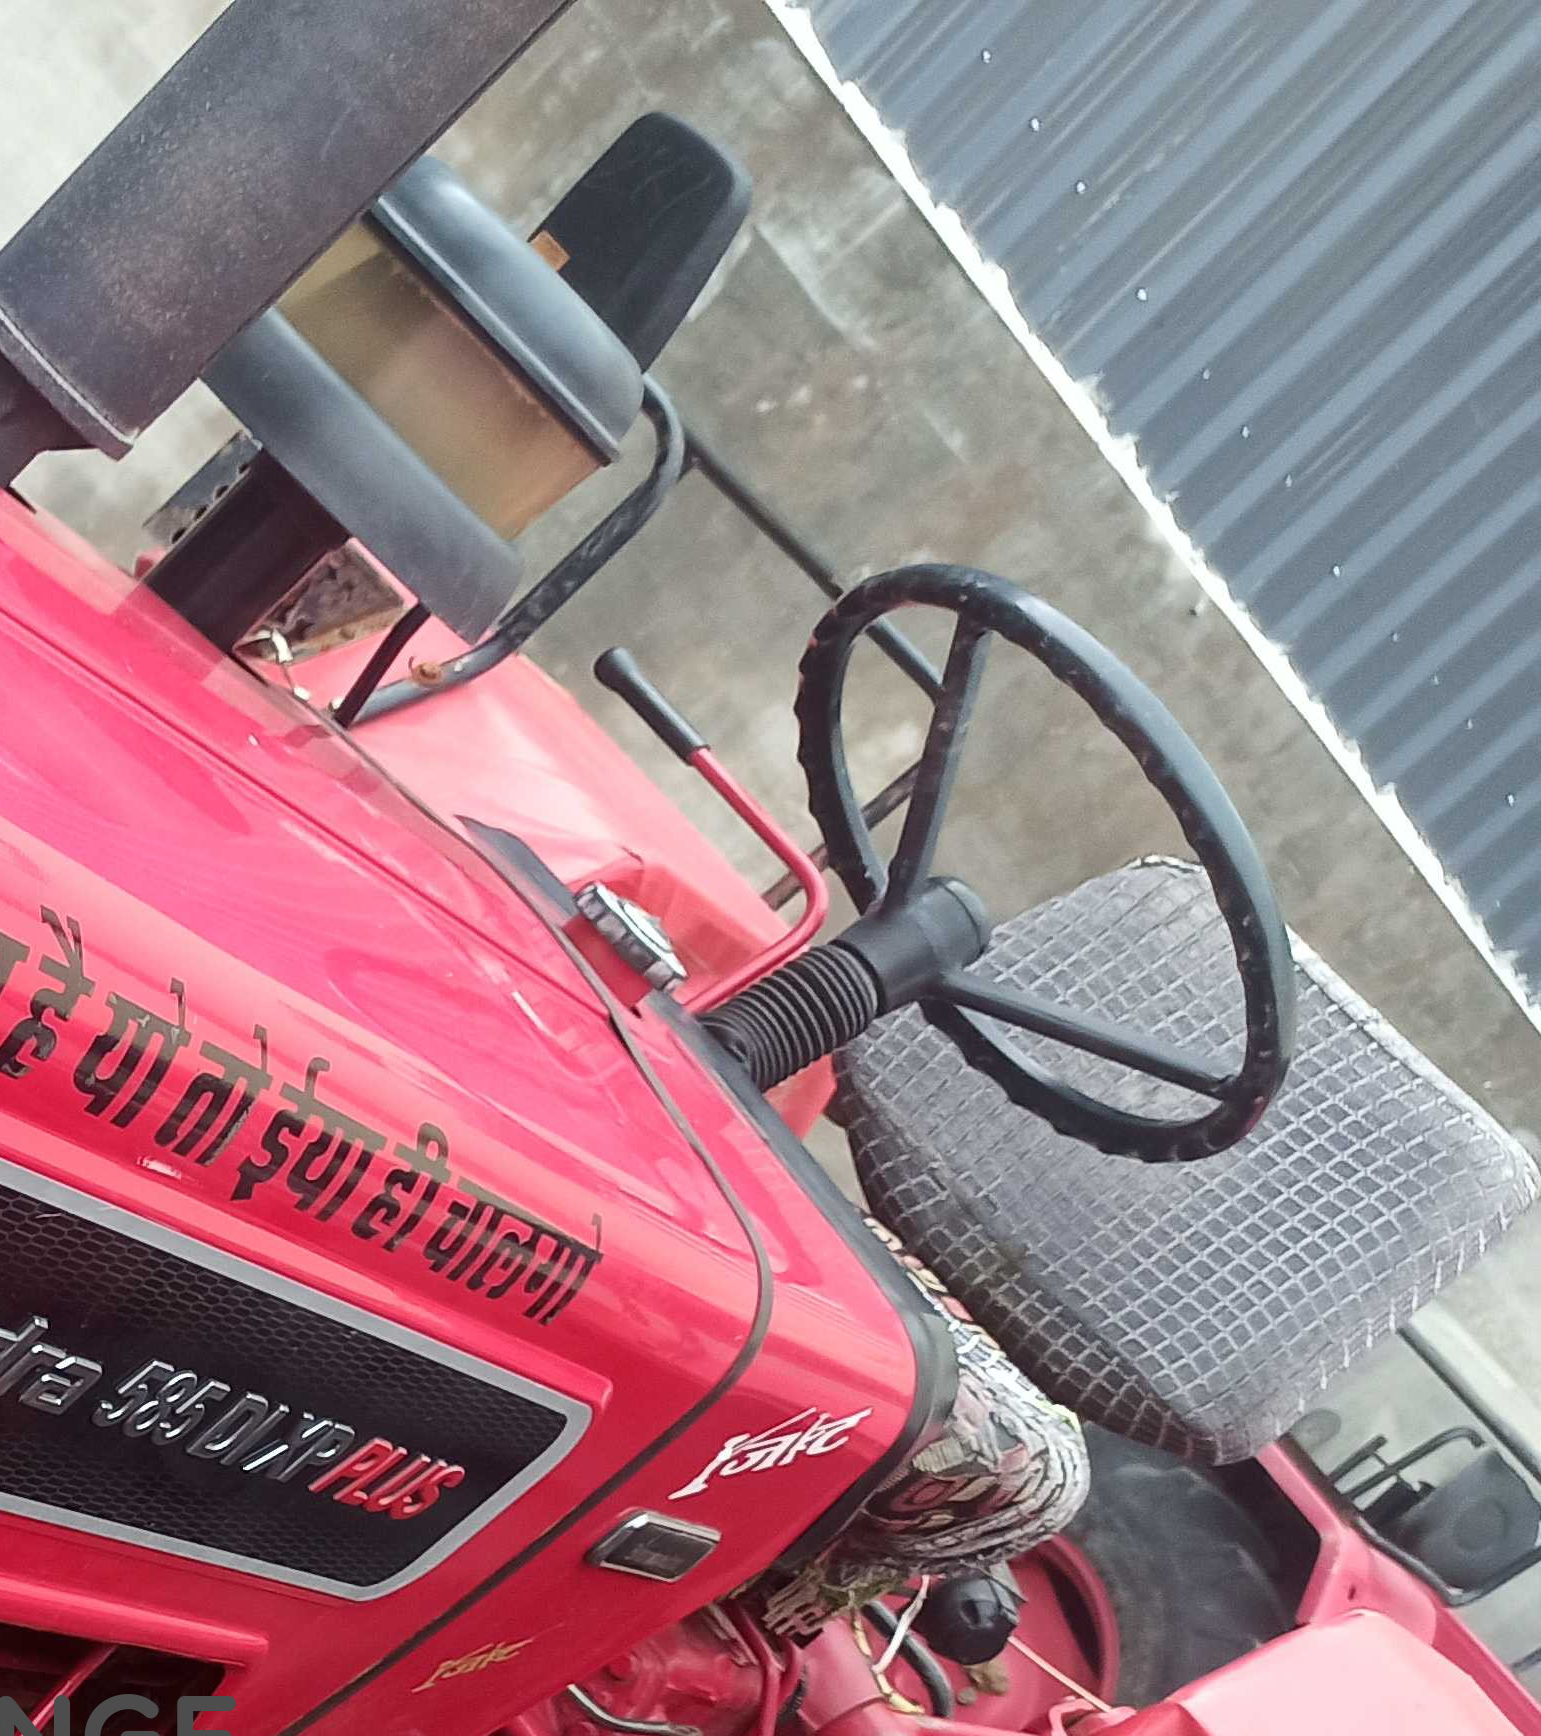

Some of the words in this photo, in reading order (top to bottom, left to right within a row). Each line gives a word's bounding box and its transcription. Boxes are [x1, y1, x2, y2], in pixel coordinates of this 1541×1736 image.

[72, 978, 191, 1129] यो
[153, 1024, 271, 1166] तो
[350, 1122, 450, 1252] ही
[92, 1360, 231, 1446] 585
[308, 1437, 466, 1521] PLUS
